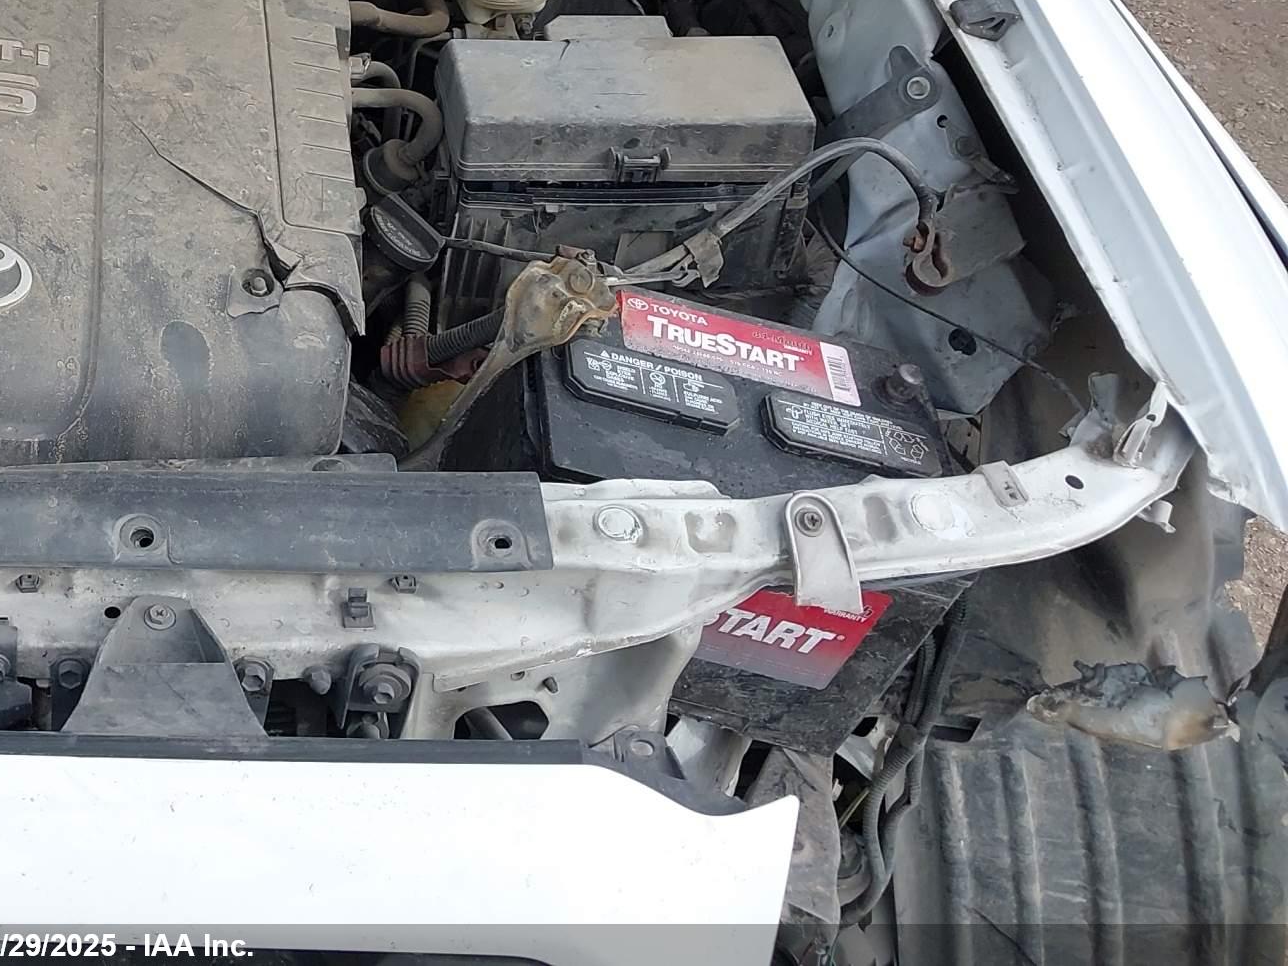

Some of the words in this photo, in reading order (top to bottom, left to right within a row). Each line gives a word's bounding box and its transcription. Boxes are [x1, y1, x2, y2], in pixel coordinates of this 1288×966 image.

[650, 303, 709, 326] TOYOTA
[611, 352, 654, 370] DANGER
[664, 366, 703, 382] POISON
